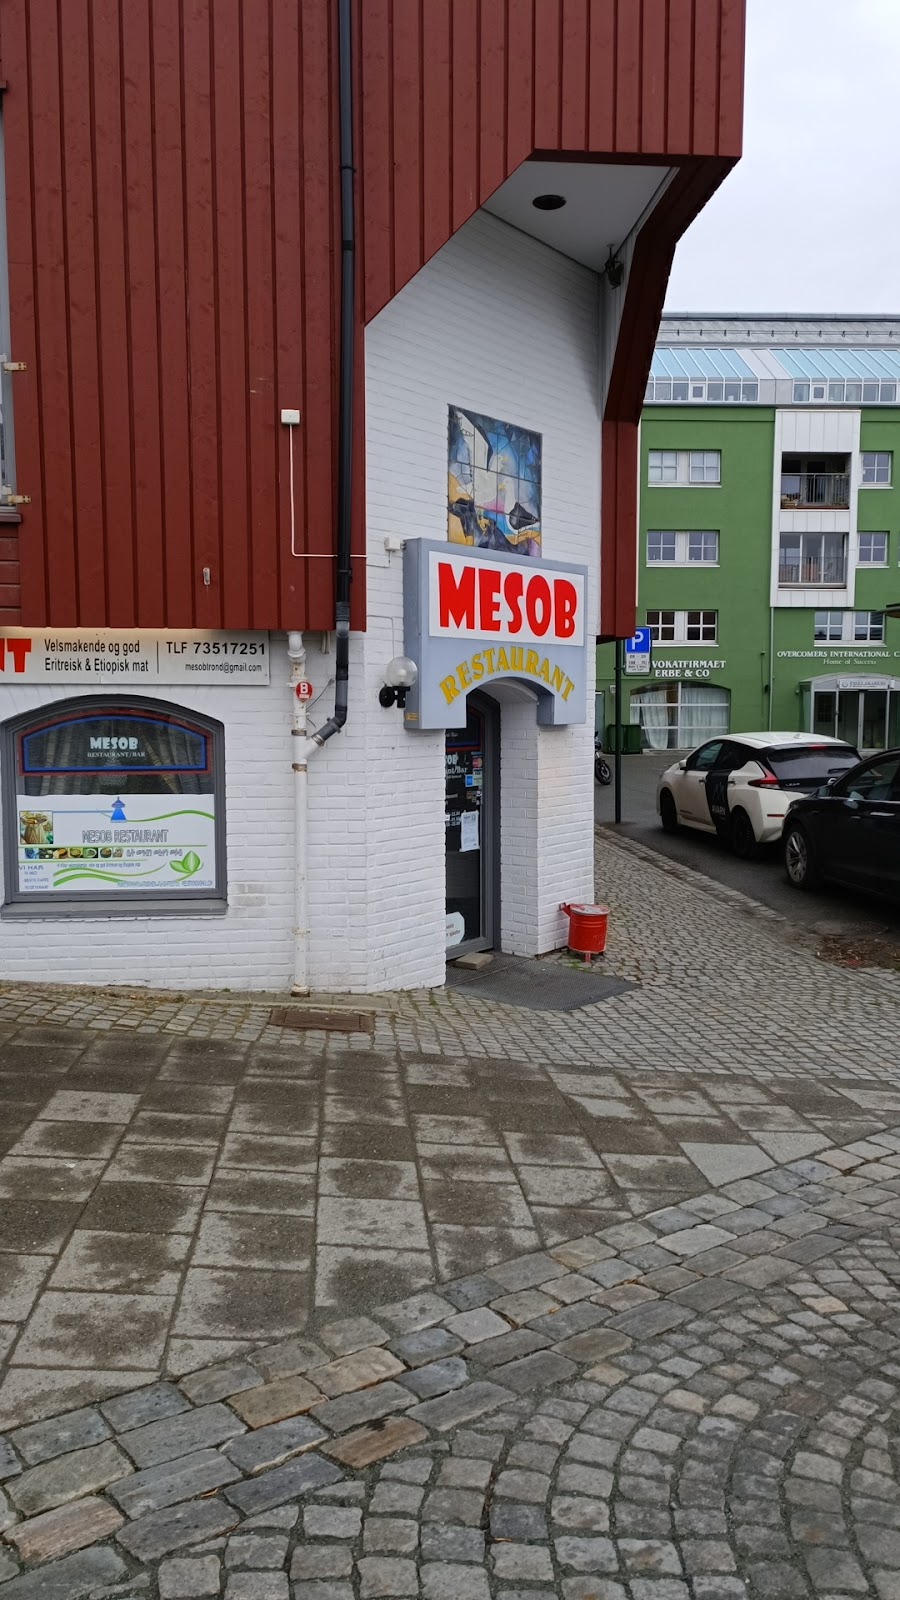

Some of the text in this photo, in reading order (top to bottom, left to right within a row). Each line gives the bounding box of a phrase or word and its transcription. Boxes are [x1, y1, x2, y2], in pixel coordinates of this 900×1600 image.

[438, 562, 577, 638] MESOB
[44, 639, 139, 656] Velsmakende og god
[166, 642, 265, 655] TLF 73517251
[45, 658, 149, 674] Eritreisk & Etiopisk mat
[655, 669, 710, 677] ERBE & CO
[439, 646, 575, 705] RESTAURANT
[300, 682, 309, 694] B
[90, 736, 139, 750] MESOB
[82, 829, 169, 843] MESOB RESTAURANT
